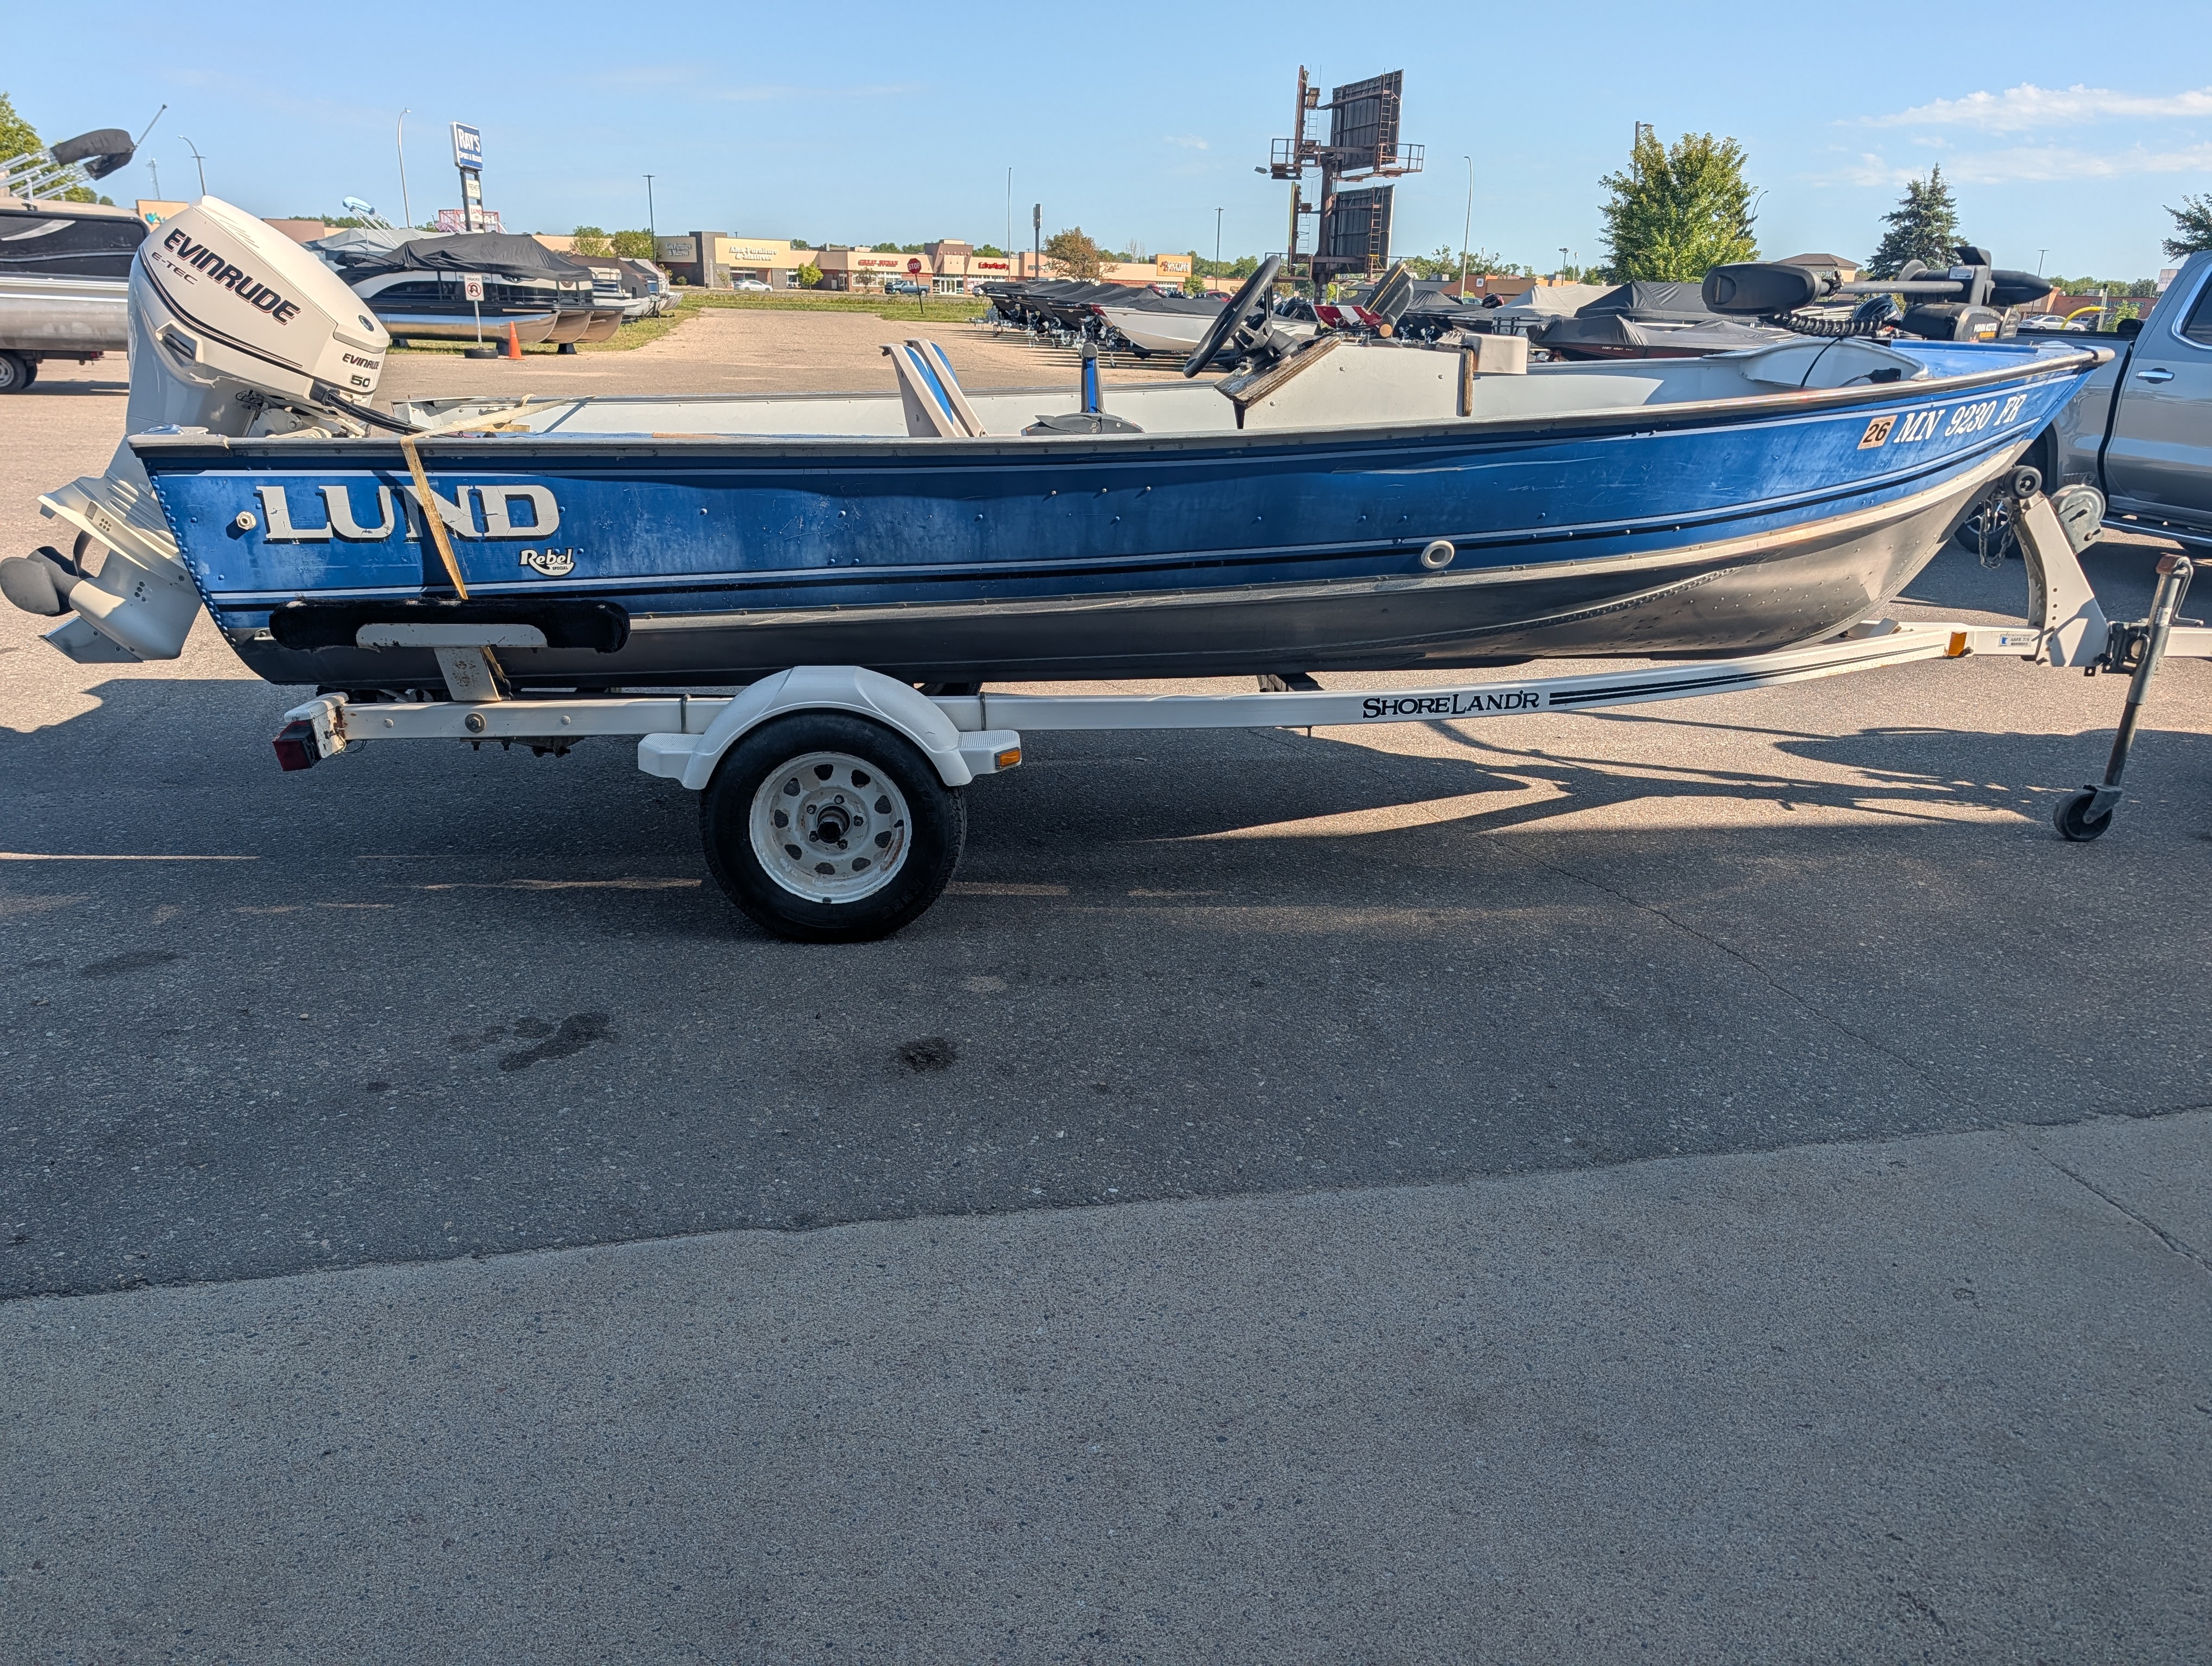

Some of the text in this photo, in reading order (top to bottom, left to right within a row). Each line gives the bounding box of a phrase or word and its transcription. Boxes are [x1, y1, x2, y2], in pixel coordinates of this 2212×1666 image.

[458, 128, 480, 153] RAY'S
[151, 252, 198, 285] E-TEC
[163, 228, 301, 325] EVINRUDE
[908, 262, 921, 271] STOP
[342, 353, 380, 370] EVINRUDE
[350, 374, 371, 388] 50
[1862, 421, 1891, 443] 26
[1893, 409, 1945, 443] MN
[1945, 401, 1997, 437] 9230
[254, 485, 560, 544] LUND
[519, 547, 575, 576] Rebel
[1362, 690, 1539, 719] SHORELAND'R
